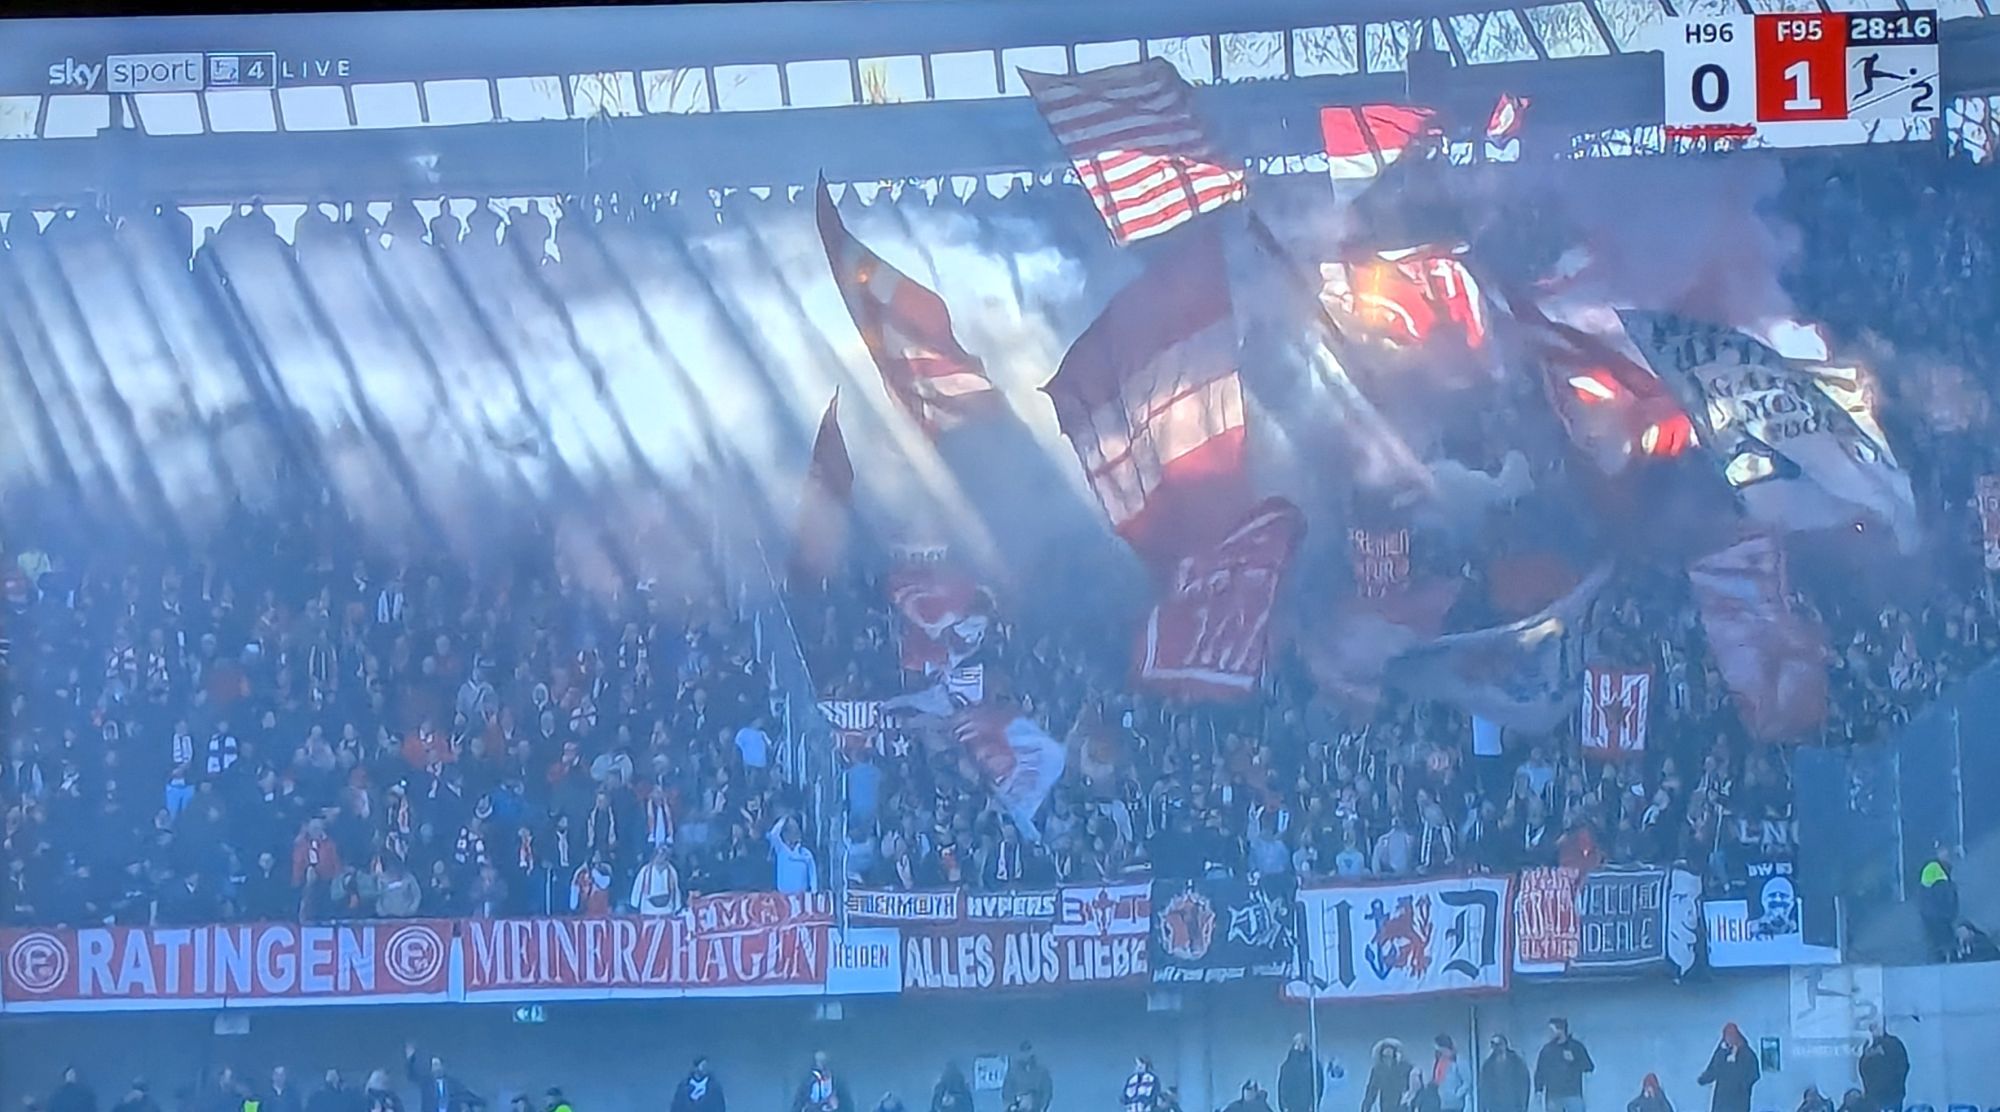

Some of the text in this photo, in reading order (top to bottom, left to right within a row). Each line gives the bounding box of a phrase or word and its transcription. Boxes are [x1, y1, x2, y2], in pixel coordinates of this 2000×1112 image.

[1686, 22, 1734, 43] H96
[1777, 19, 1823, 42] F95
[1851, 16, 1932, 40] 28:16
[49, 56, 351, 91] sky sport 4 LIVE
[1691, 63, 1730, 112] 0
[1783, 60, 1822, 111] 1
[1910, 81, 1934, 112] 2
[77, 926, 376, 996] RATINGEN
[470, 918, 818, 984] MEINERZHAGEN
[904, 931, 1148, 989] ALLES AUS LIEBE
